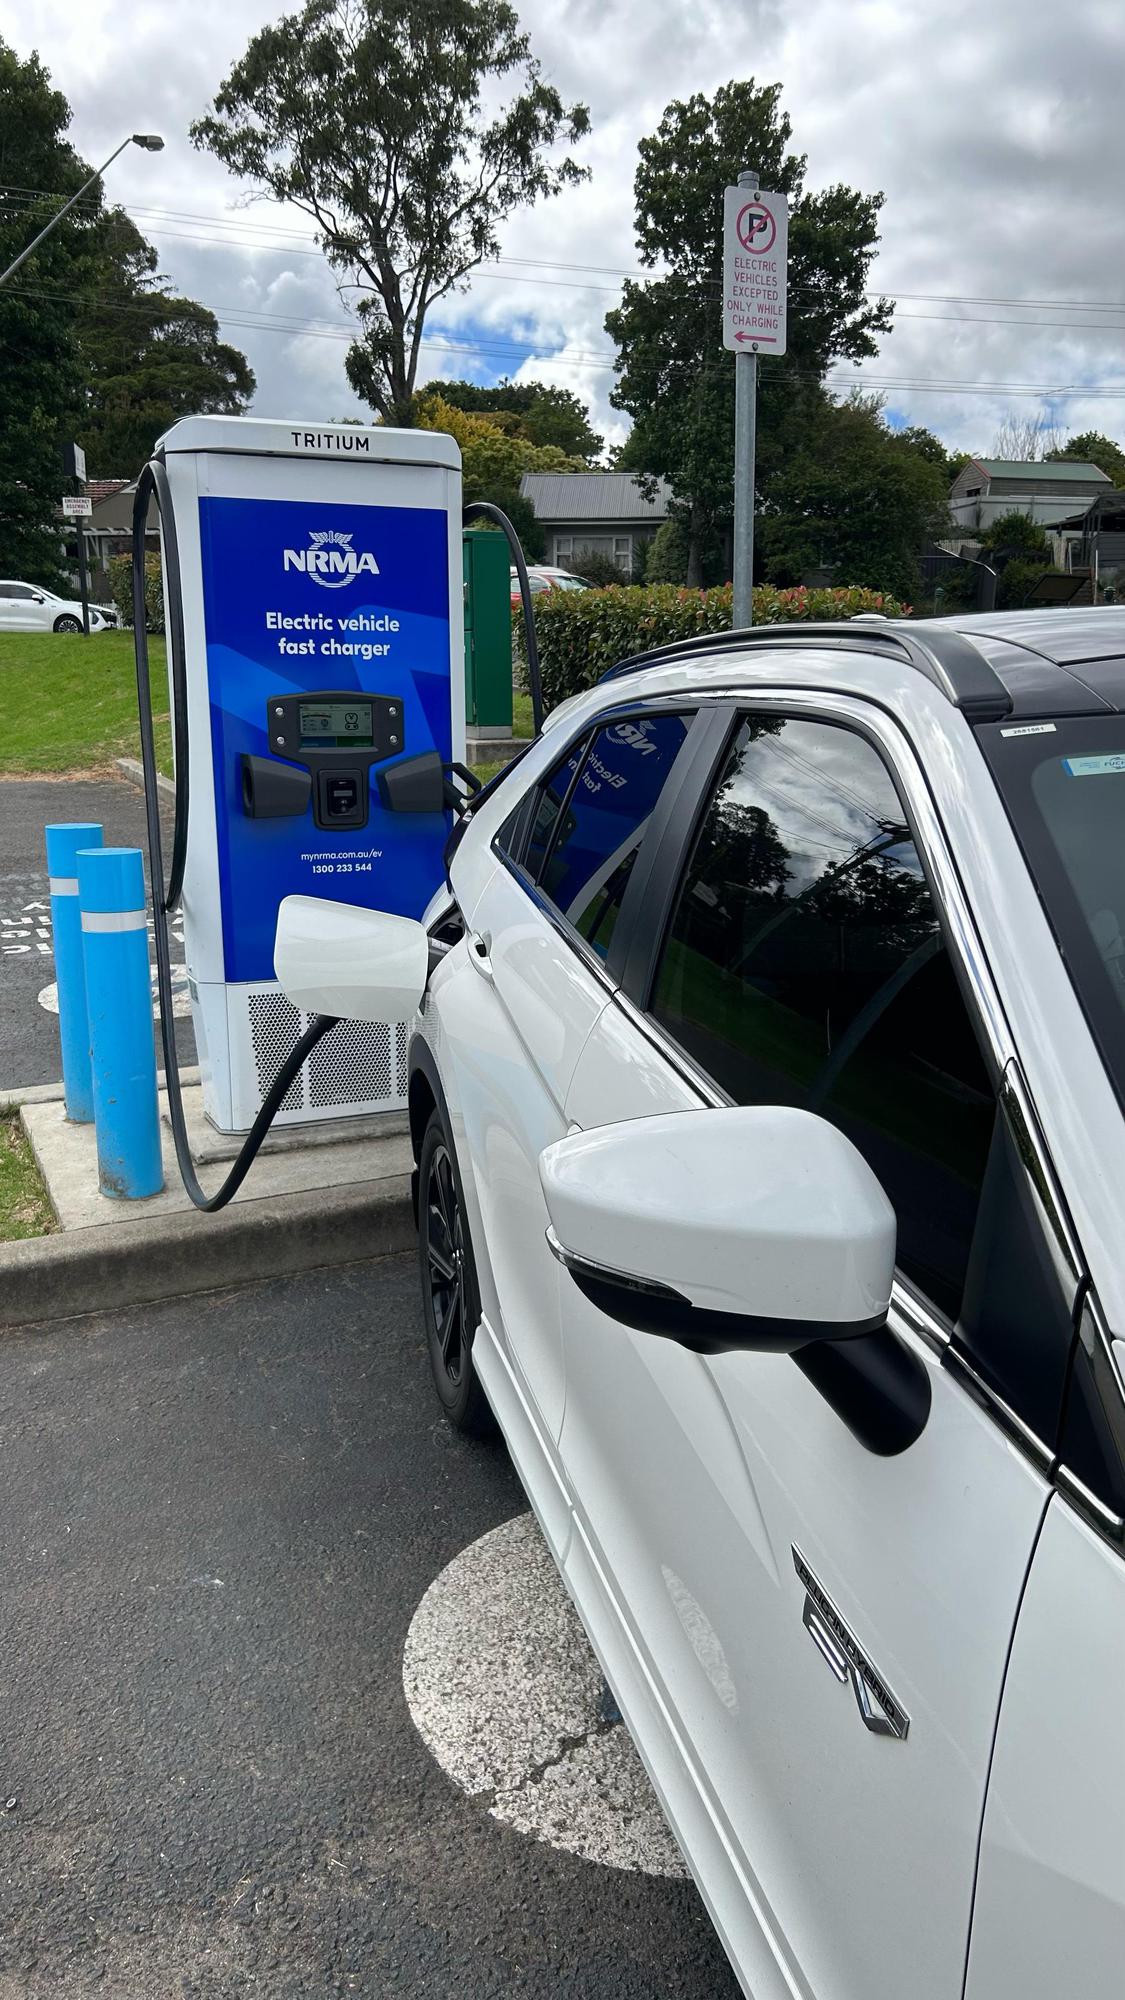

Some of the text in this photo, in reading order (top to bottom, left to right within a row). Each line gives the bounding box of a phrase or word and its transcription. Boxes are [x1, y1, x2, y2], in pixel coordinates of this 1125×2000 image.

[734, 257, 777, 273] ELECTRIC
[734, 272, 778, 287] VEHICLES
[732, 286, 778, 301] EXCEPTED
[727, 300, 784, 316] ONLY WHILE
[732, 314, 779, 329] CHARGING
[291, 432, 370, 451] TRITIUM
[283, 549, 380, 575] NRMA
[266, 612, 400, 632] Electric vehicle
[278, 637, 391, 660] fast charger
[301, 849, 383, 862] mynrma.com.au/ev
[312, 863, 372, 874] 1300 233 544
[798, 1564, 896, 1719] PLUG-IN HYBRID
